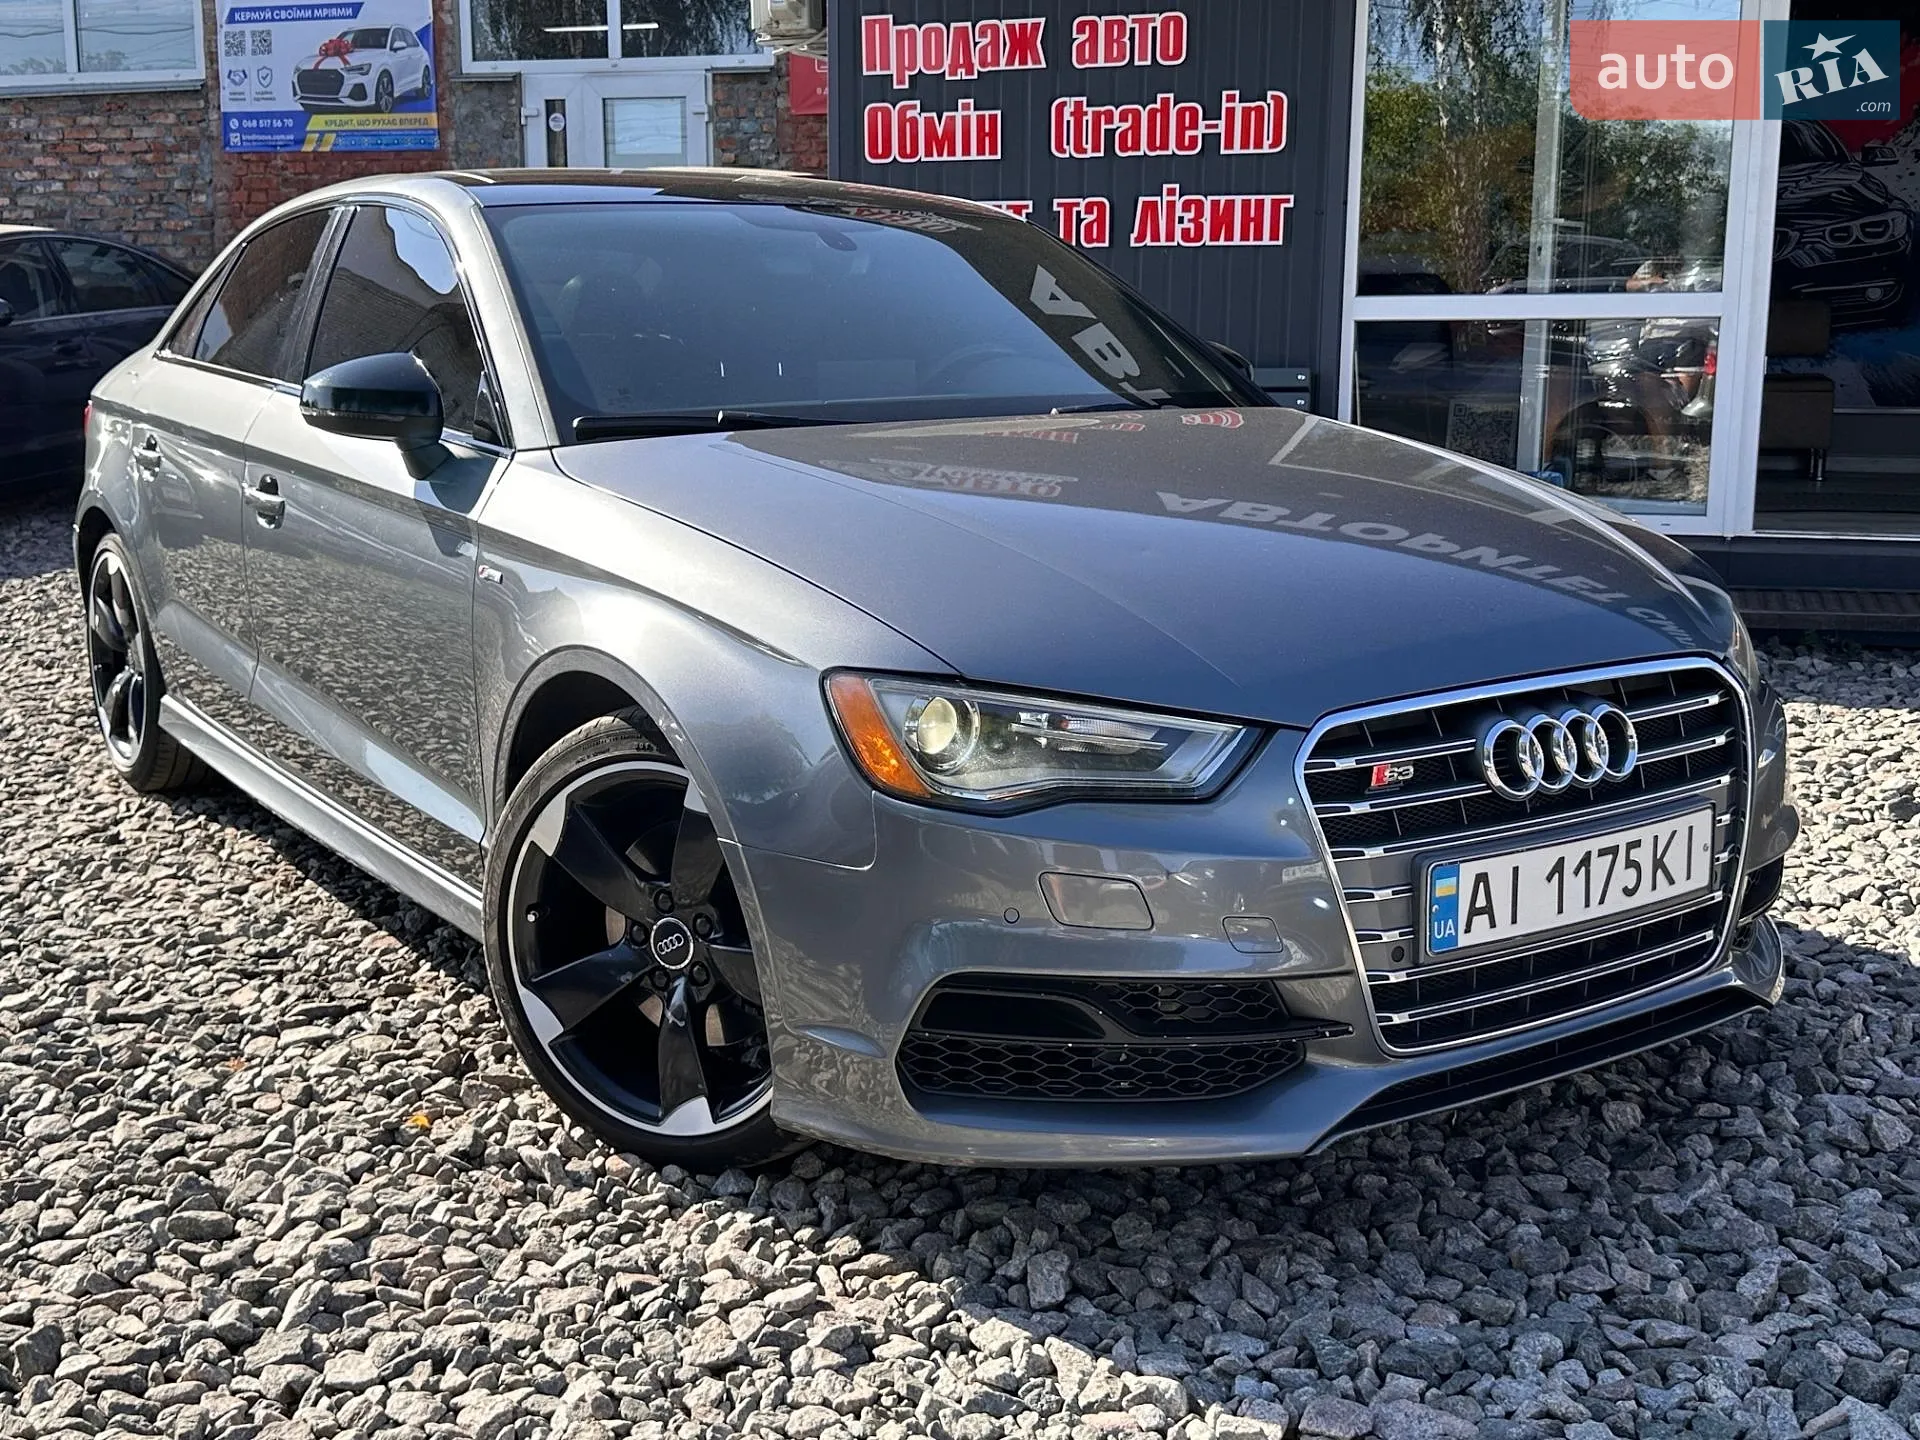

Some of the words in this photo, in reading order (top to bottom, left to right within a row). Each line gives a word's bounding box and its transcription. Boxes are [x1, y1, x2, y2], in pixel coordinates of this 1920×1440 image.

[234, 9, 272, 21] КЕРМУЙ
[273, 7, 312, 20] СВОЇМИ
[313, 7, 353, 18] МРІЯМИ
[862, 14, 1047, 89] Продаж
[1072, 11, 1187, 70] авто
[284, 118, 294, 127] 70
[863, 99, 1001, 164] Обмін
[1050, 90, 1288, 158] (trade-in)
[1053, 196, 1110, 248] та
[1130, 184, 1295, 248] лізинг
[1383, 765, 1414, 782] S3
[1464, 866, 1519, 934] AI
[1434, 919, 1456, 939] UA
